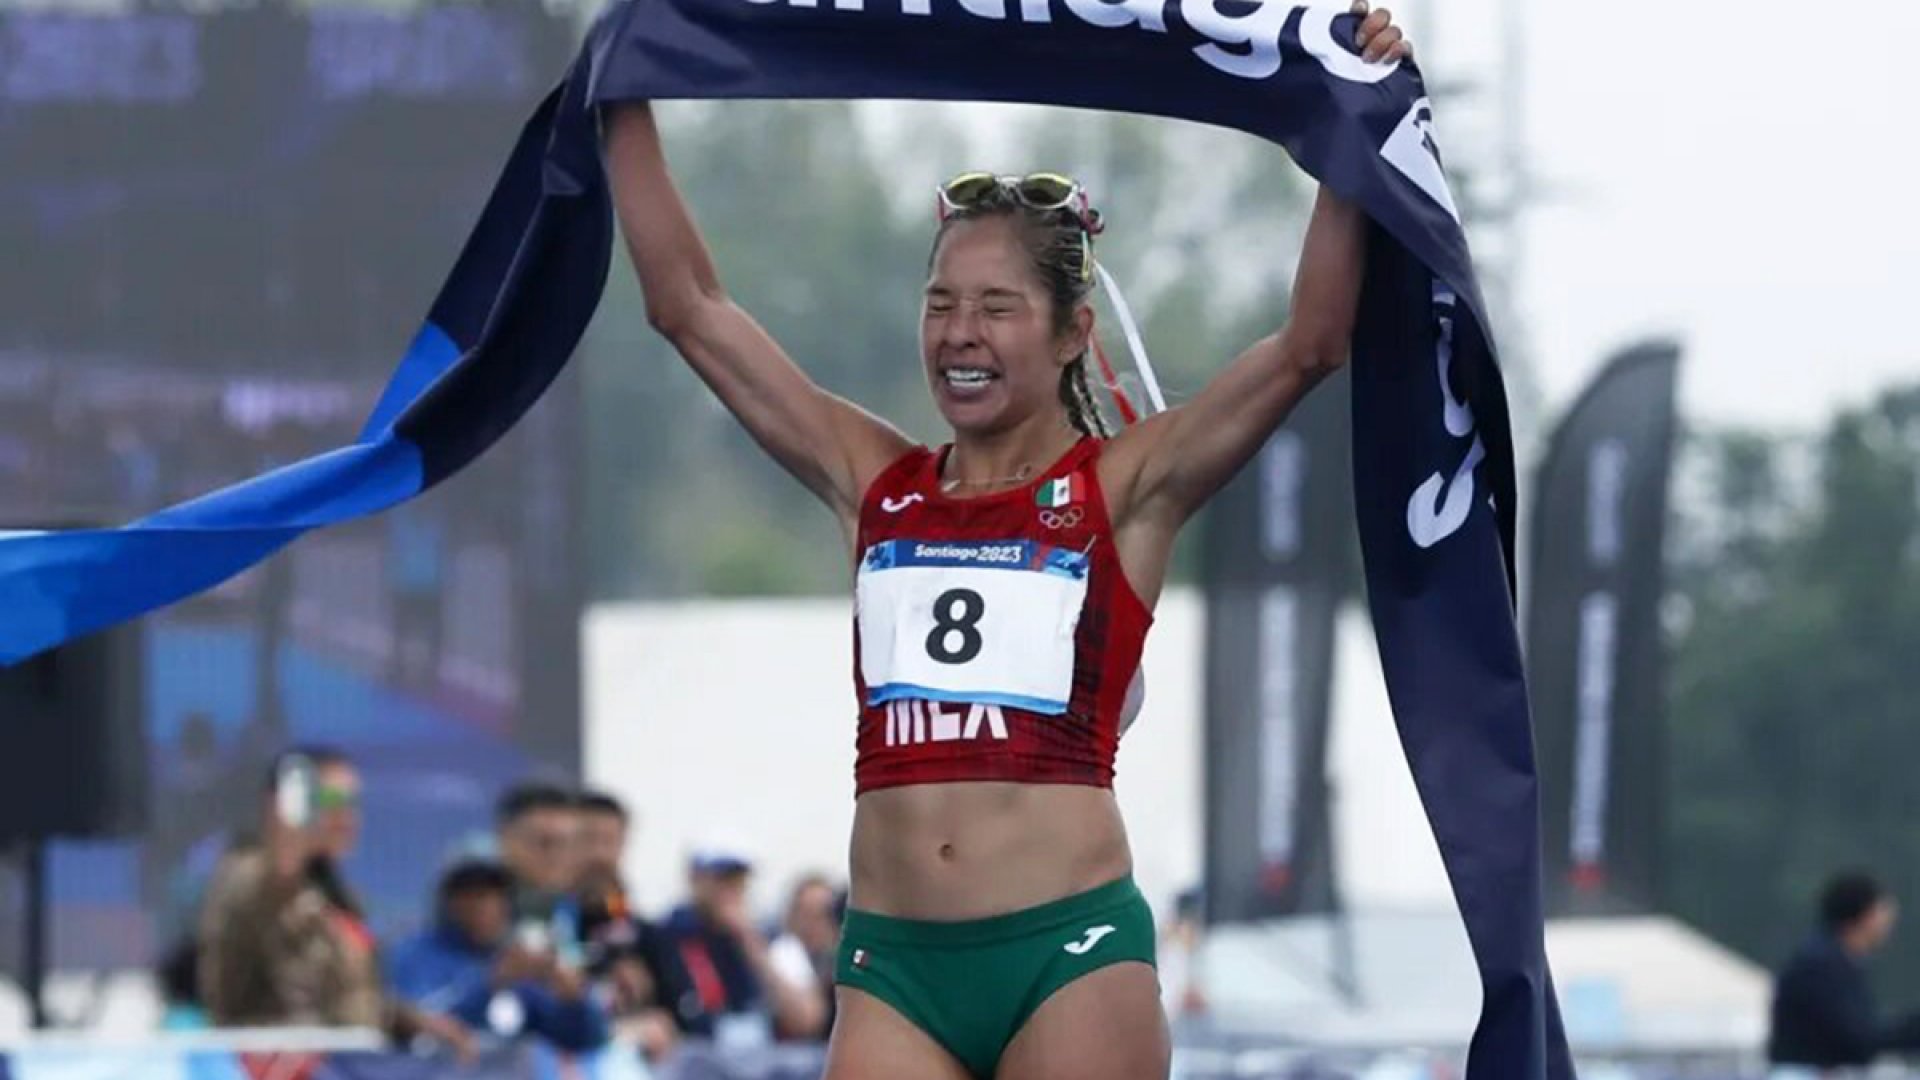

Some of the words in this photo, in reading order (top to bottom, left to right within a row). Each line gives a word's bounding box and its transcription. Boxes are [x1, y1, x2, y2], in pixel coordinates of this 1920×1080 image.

[914, 543, 978, 560] Santiago
[976, 545, 1022, 563] 2023
[925, 588, 985, 664] 8
